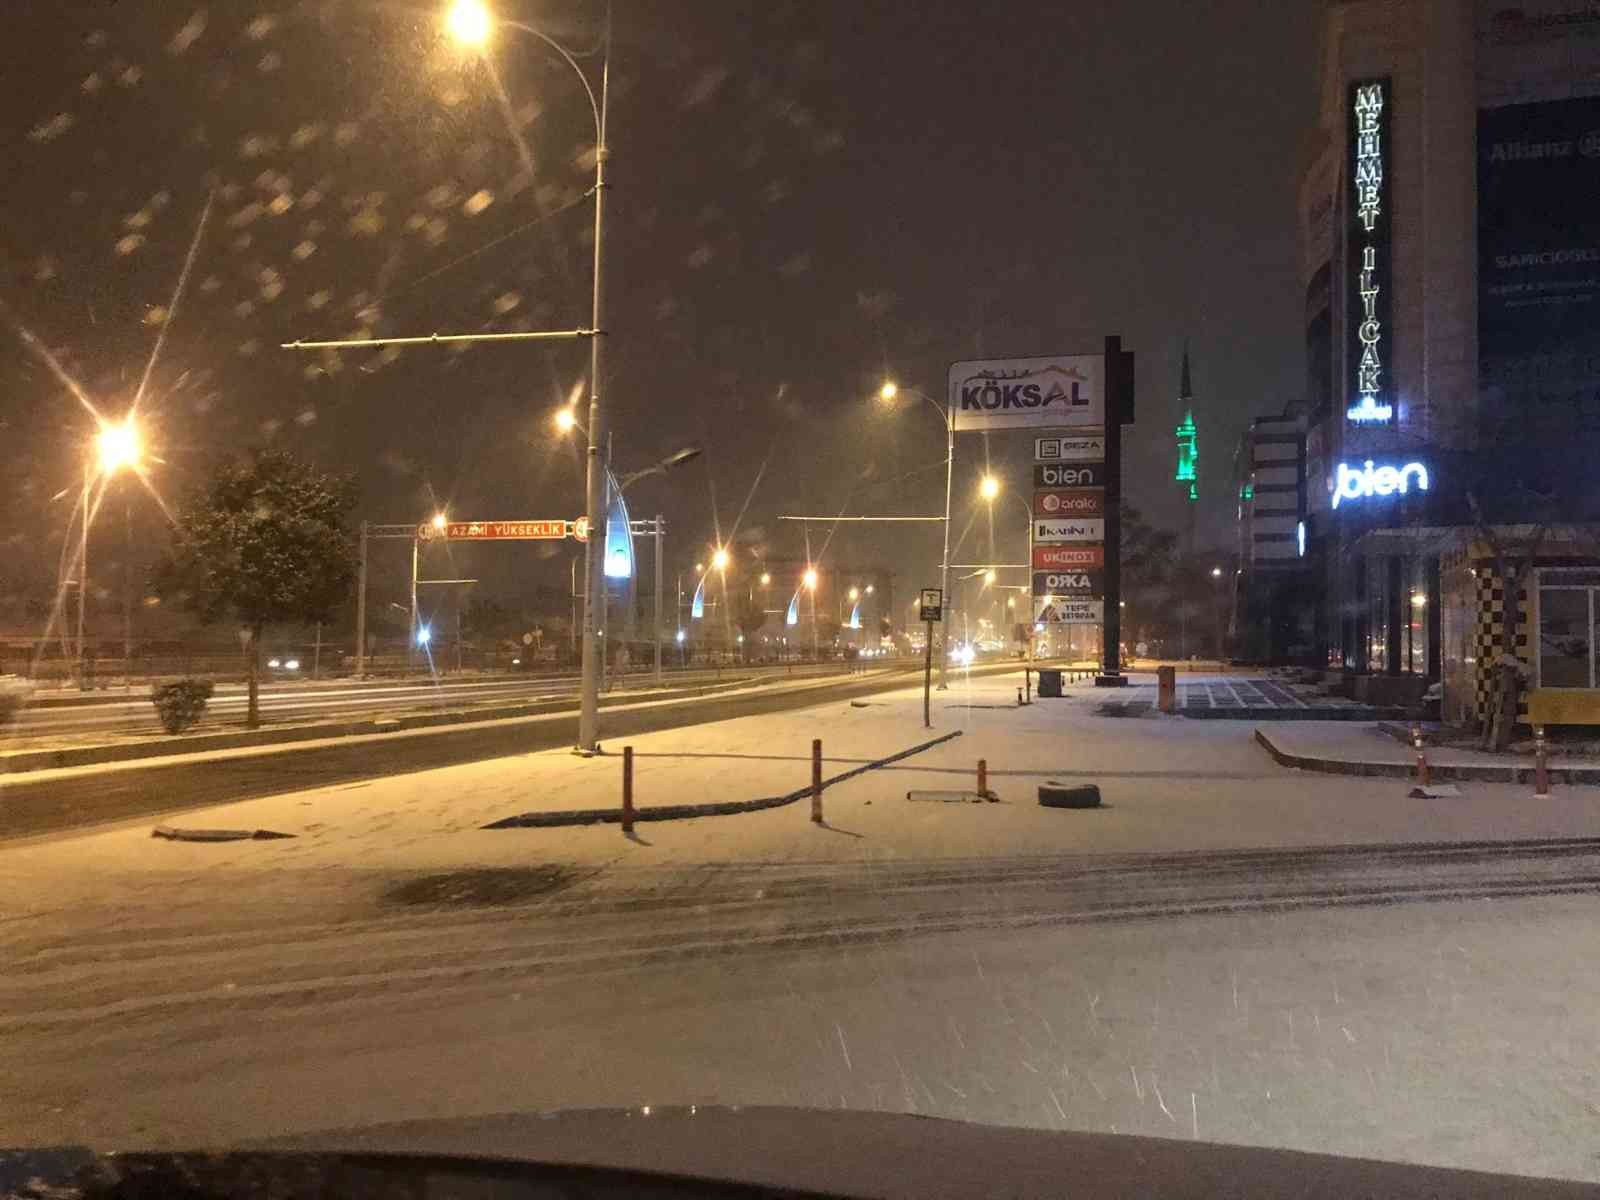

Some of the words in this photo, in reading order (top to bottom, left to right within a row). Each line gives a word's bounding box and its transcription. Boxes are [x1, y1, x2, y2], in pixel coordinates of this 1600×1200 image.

[1355, 84, 1383, 231] MEHMET
[962, 381, 1090, 410] KÖKSAL
[1043, 466, 1094, 485] bien
[1332, 459, 1428, 509] bien
[495, 522, 561, 536] YÜKSEKLİK
